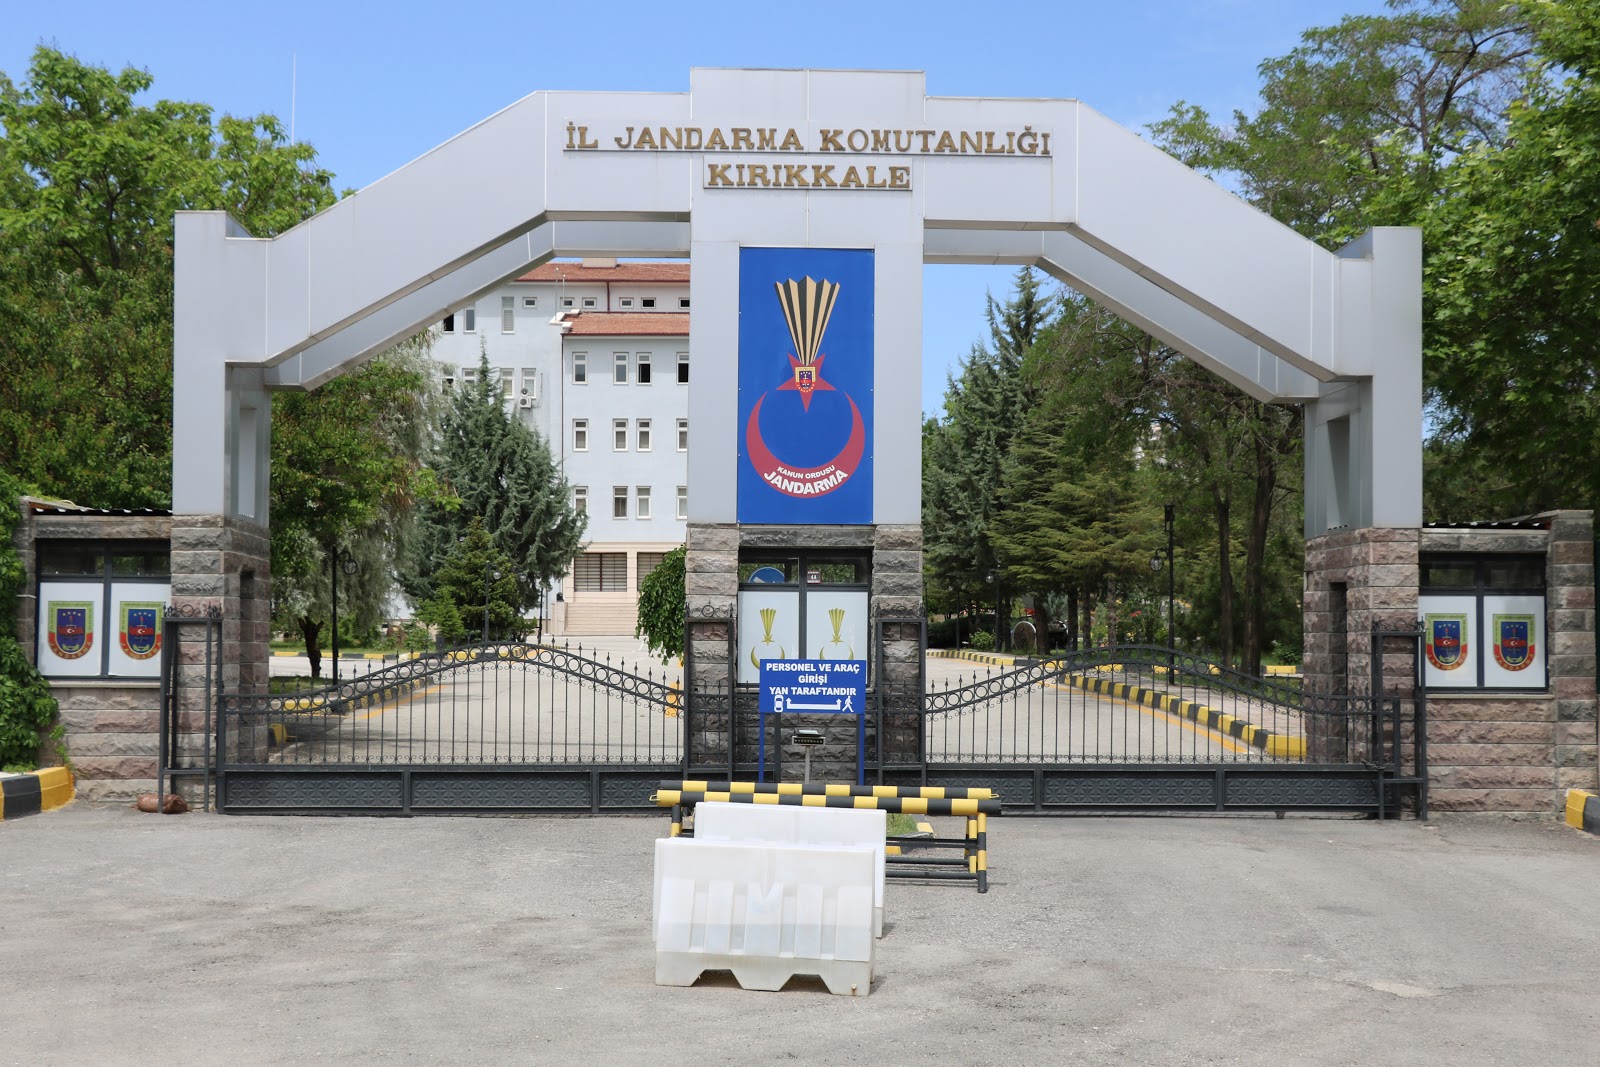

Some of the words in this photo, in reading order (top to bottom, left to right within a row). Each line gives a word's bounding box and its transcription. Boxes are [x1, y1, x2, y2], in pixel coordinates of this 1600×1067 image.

[566, 121, 598, 149] İL
[614, 126, 804, 151] JANDARMA
[820, 125, 1051, 155] KOMUTANLIĞI
[707, 163, 911, 188] KIRIKKALE
[777, 465, 804, 479] KANUN
[805, 464, 835, 479] ORDUSU
[763, 469, 848, 495] JANDARMA
[766, 663, 816, 672] PERSONEL
[818, 663, 831, 672] VE
[834, 664, 860, 674] ARAÇ
[798, 674, 828, 685] GİRİŞİ
[769, 687, 789, 695] YAN
[791, 687, 857, 696] TARAFTANDIR
